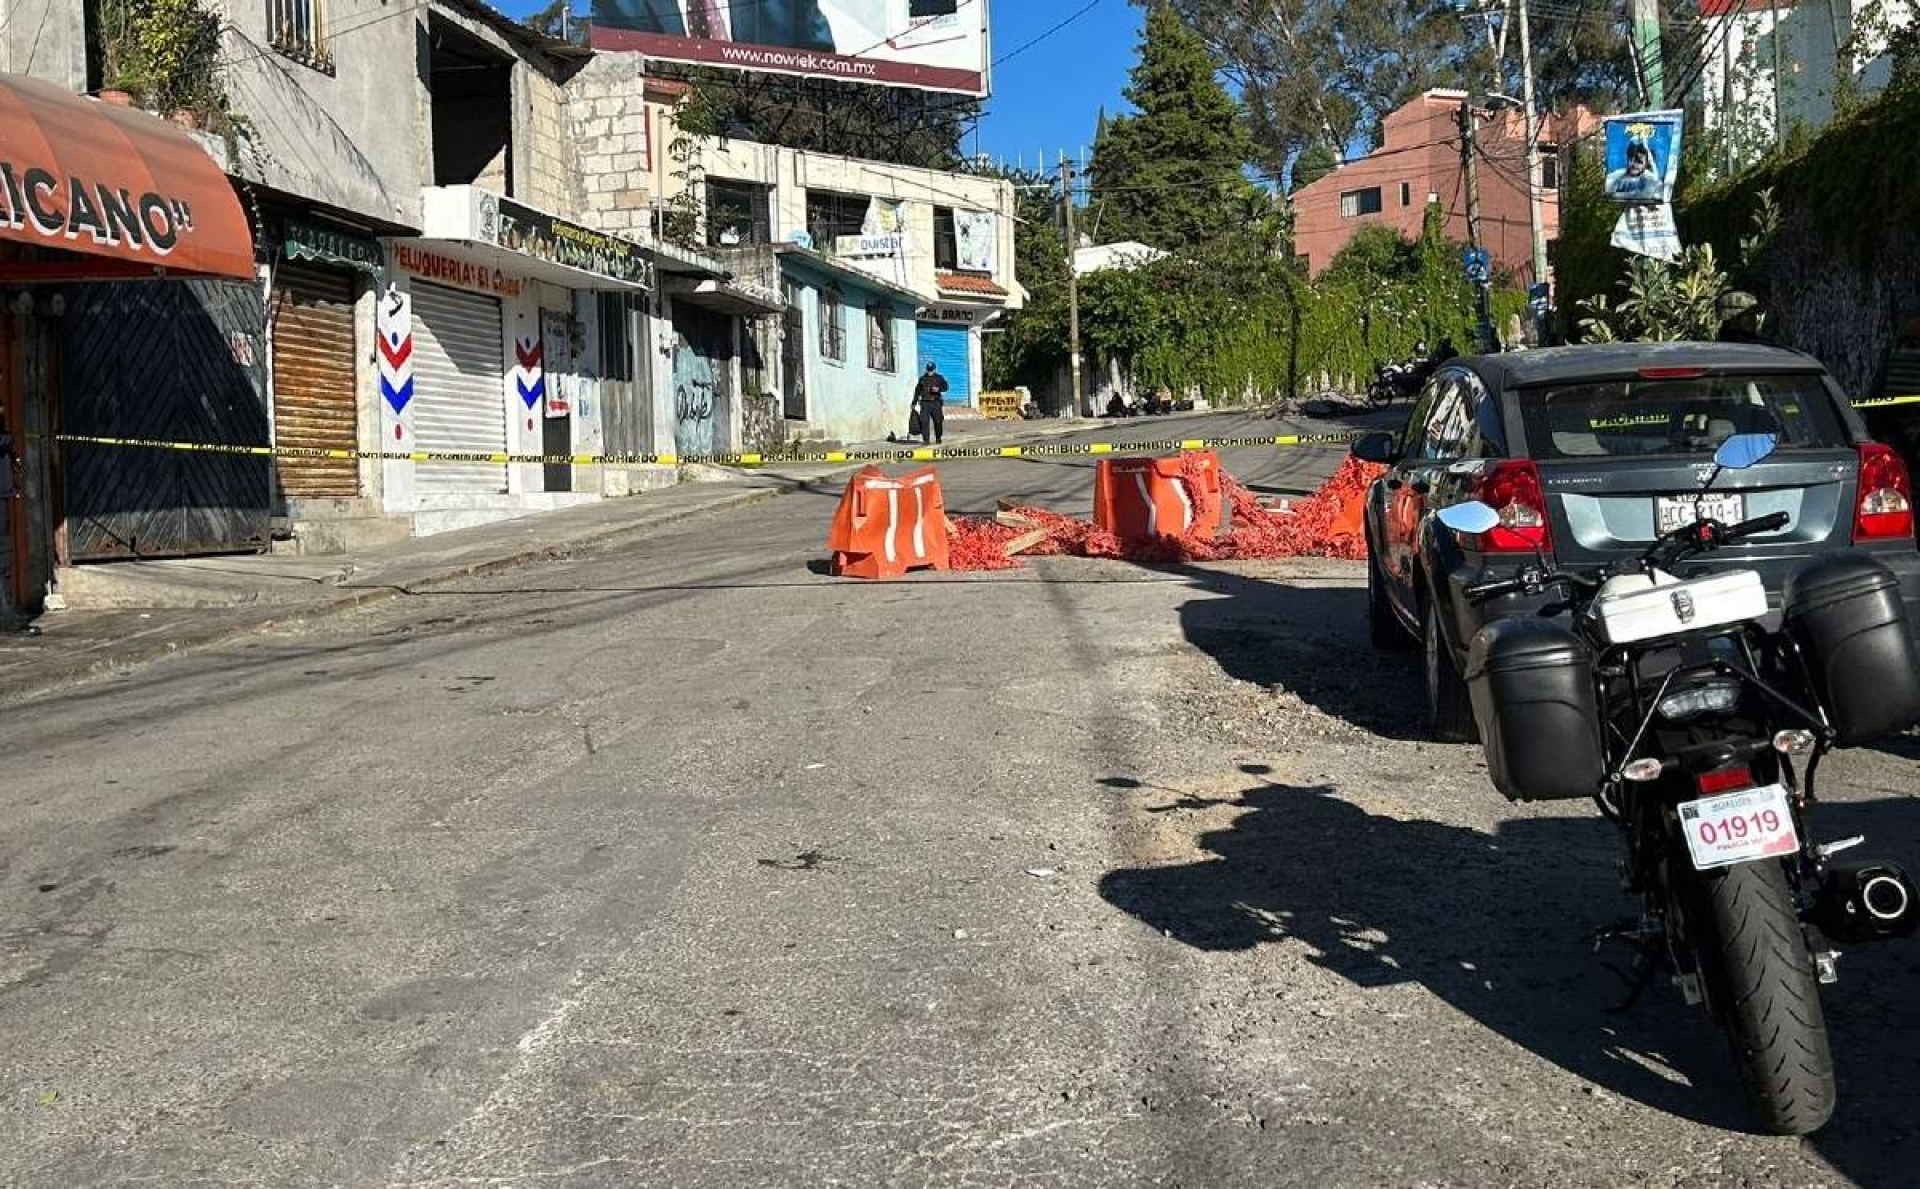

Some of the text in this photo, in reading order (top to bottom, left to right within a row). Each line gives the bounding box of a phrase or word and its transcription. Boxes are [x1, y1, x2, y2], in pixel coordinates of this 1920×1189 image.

[0, 163, 193, 256] ICANO"
[592, 453, 657, 464] PROHIBIDO
[676, 453, 741, 464] PROHIBIDO
[760, 450, 826, 462] PROHIBIDO
[846, 449, 914, 460] PROHIBIDO
[932, 447, 1000, 458] PROHIBIDO
[1021, 444, 1091, 455] PROHIBIDO
[1112, 440, 1182, 451] PROHIBIDO
[1202, 436, 1276, 447] PROHIBIDO
[1700, 809, 1780, 844] 01919
